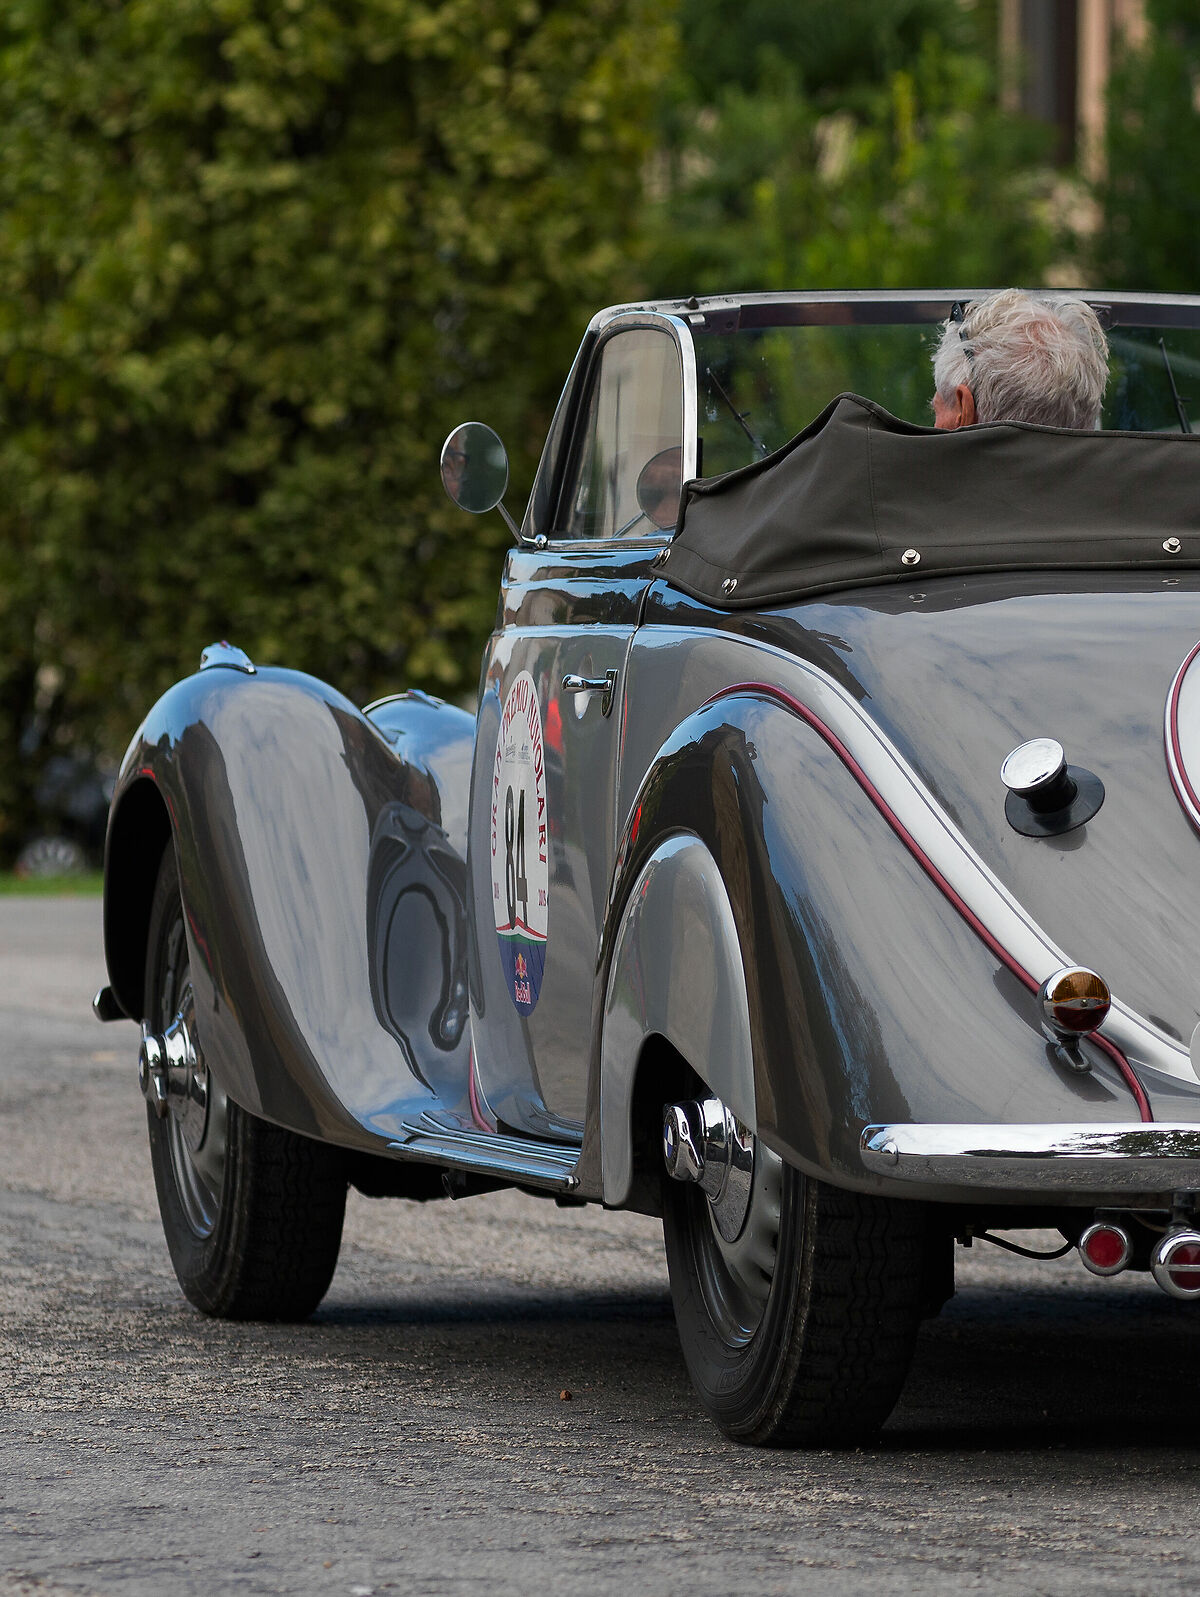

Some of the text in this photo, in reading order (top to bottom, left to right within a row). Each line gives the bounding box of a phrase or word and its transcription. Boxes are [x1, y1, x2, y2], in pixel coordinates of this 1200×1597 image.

[502, 679, 529, 746] PREMIO
[527, 692, 547, 864] NUVOLARI
[505, 785, 528, 930] 84
